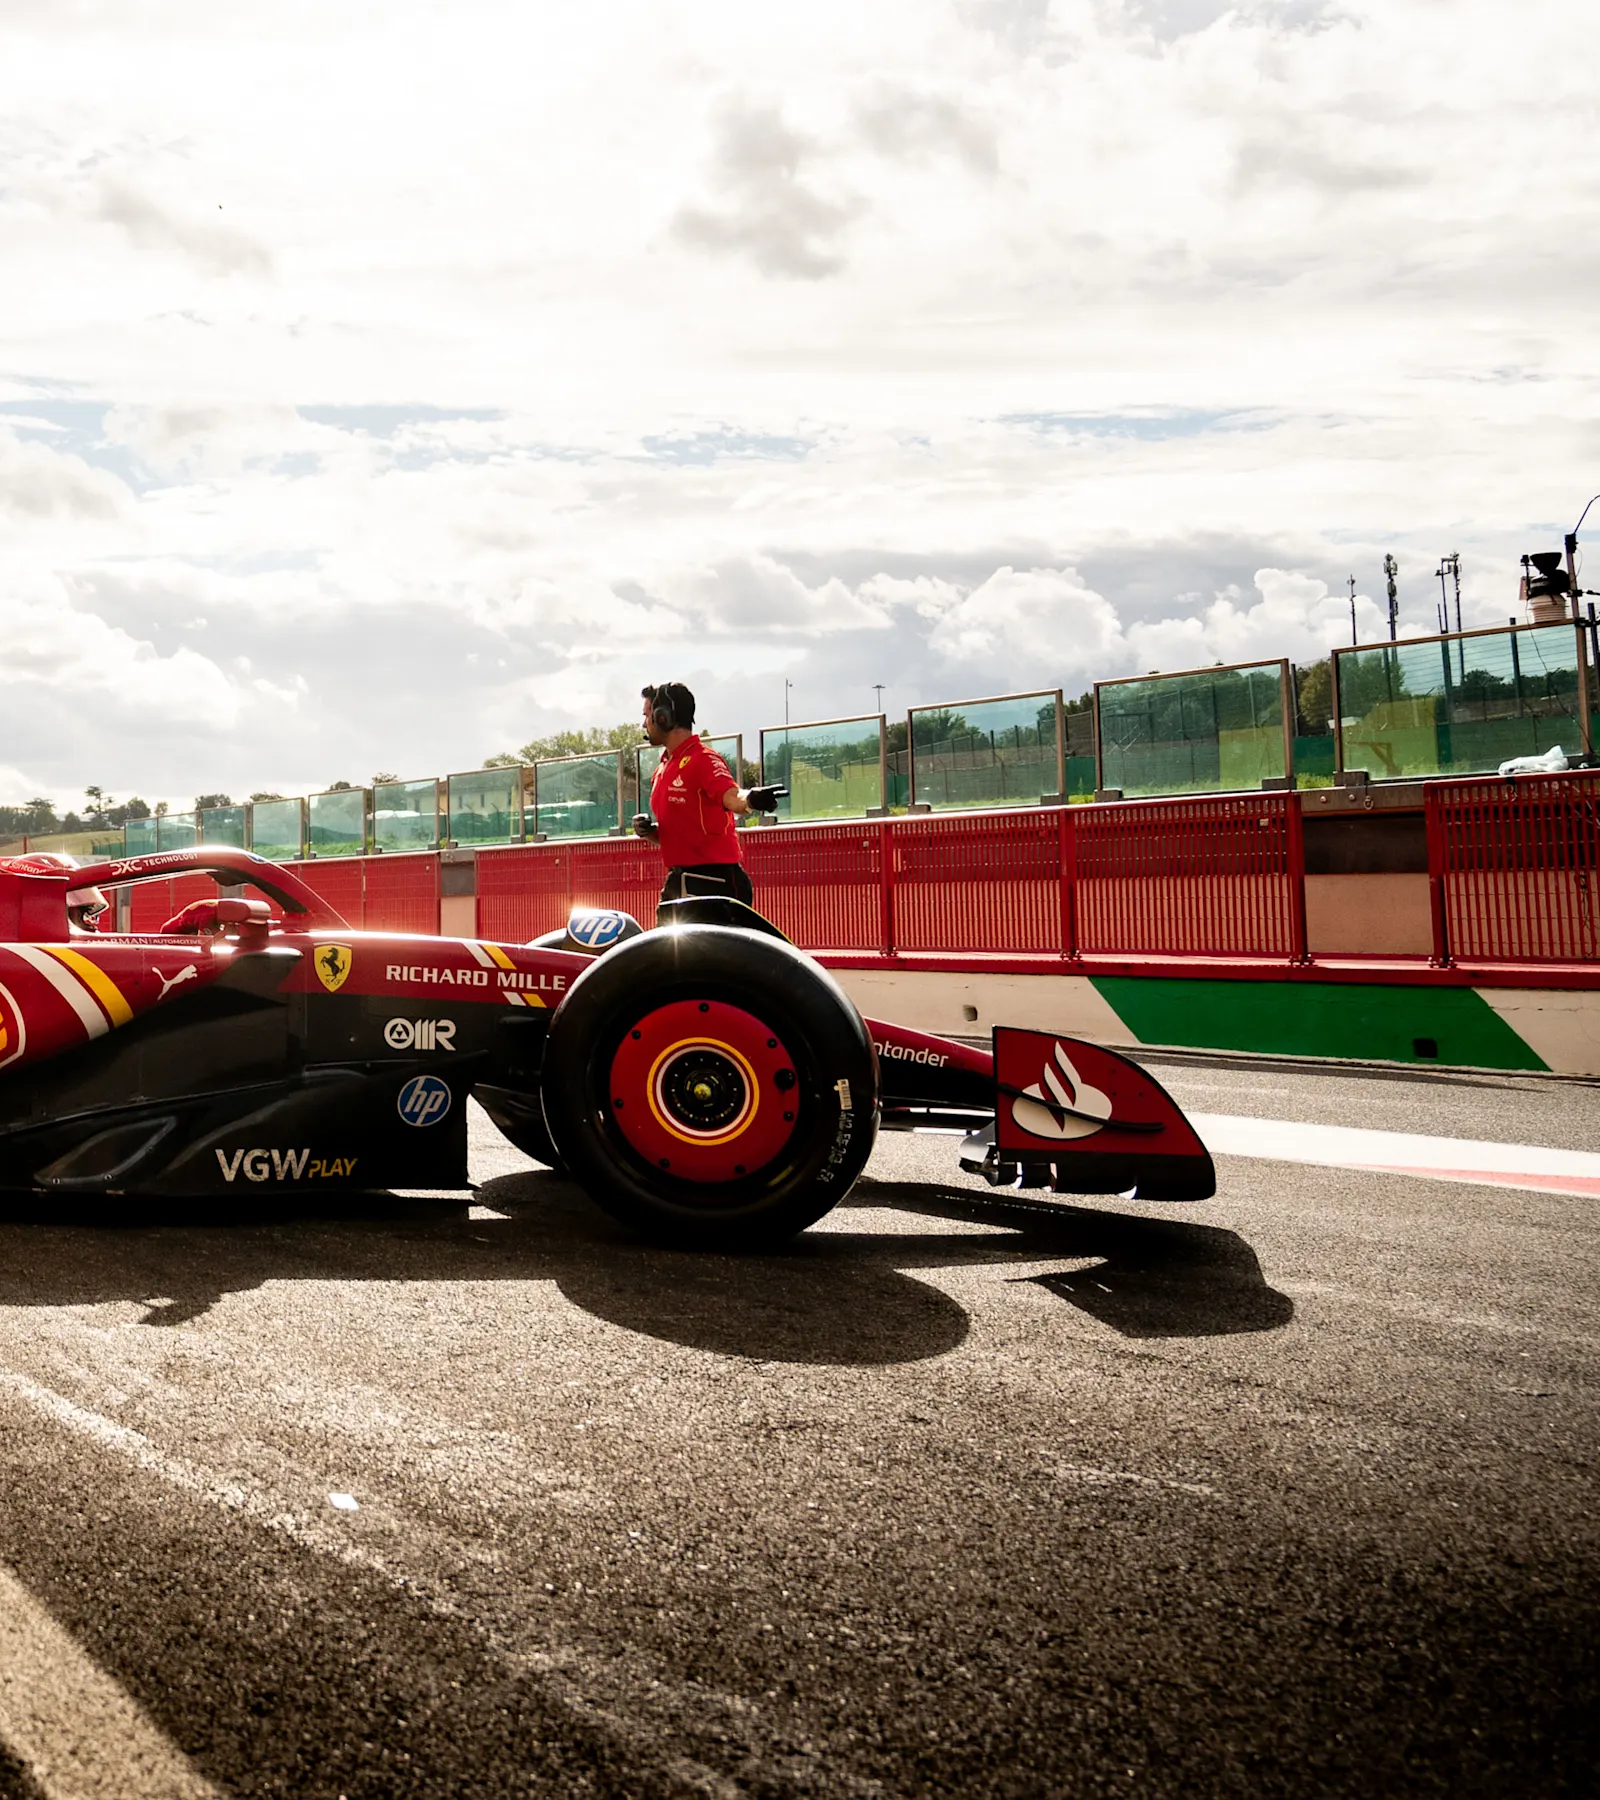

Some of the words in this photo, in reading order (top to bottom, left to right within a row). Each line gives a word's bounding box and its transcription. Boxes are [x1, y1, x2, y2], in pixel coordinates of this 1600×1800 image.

[9, 861, 47, 874] Santan
[110, 860, 142, 876] DXC
[143, 853, 198, 866] TECHNOLOGY
[385, 964, 489, 987] RICHARD
[497, 971, 567, 992] MILLE
[874, 1040, 949, 1068] ntander
[404, 1076, 446, 1126] hp
